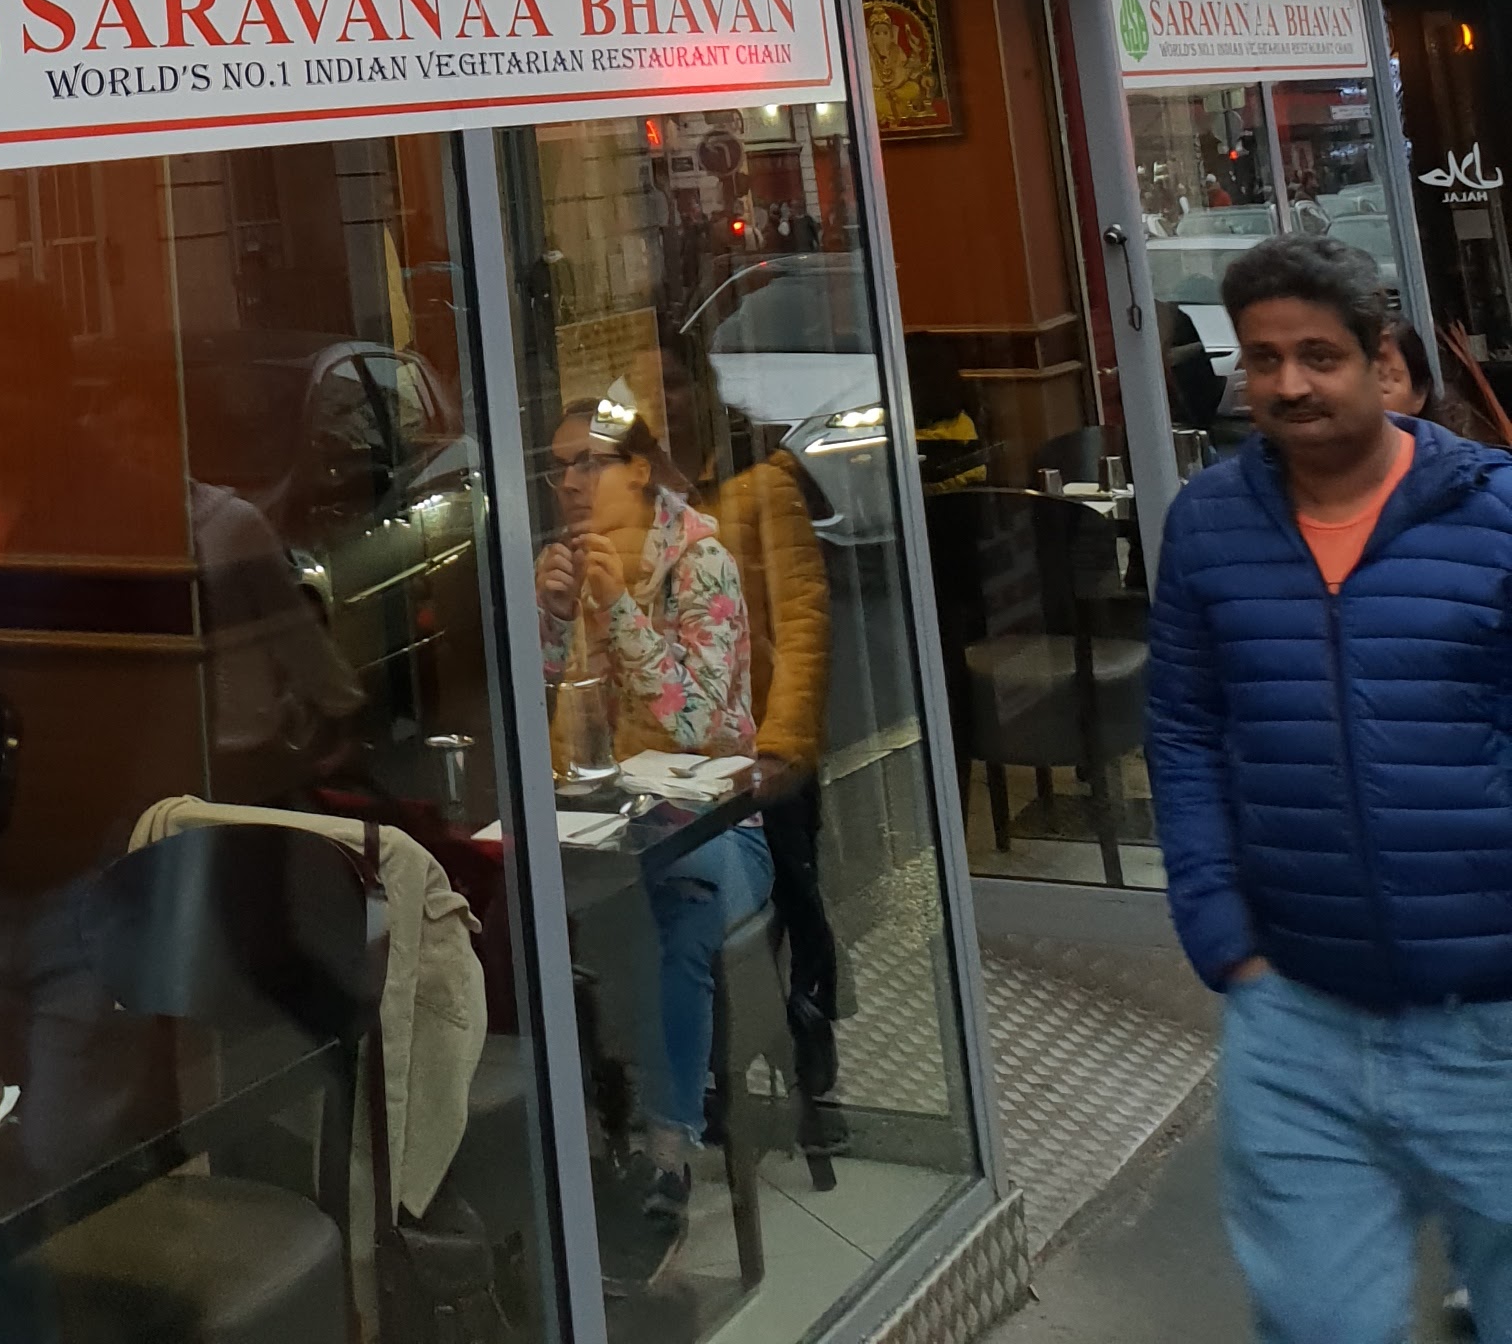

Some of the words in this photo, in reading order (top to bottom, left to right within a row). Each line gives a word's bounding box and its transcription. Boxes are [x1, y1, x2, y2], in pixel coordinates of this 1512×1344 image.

[1286, 3, 1353, 39] BHAVAN
[44, 62, 211, 100] WORLD'S
[222, 61, 292, 91] NO.1
[304, 54, 409, 86] INDIAN
[591, 44, 731, 72] RESTAURANT
[735, 43, 793, 66] CHAIN
